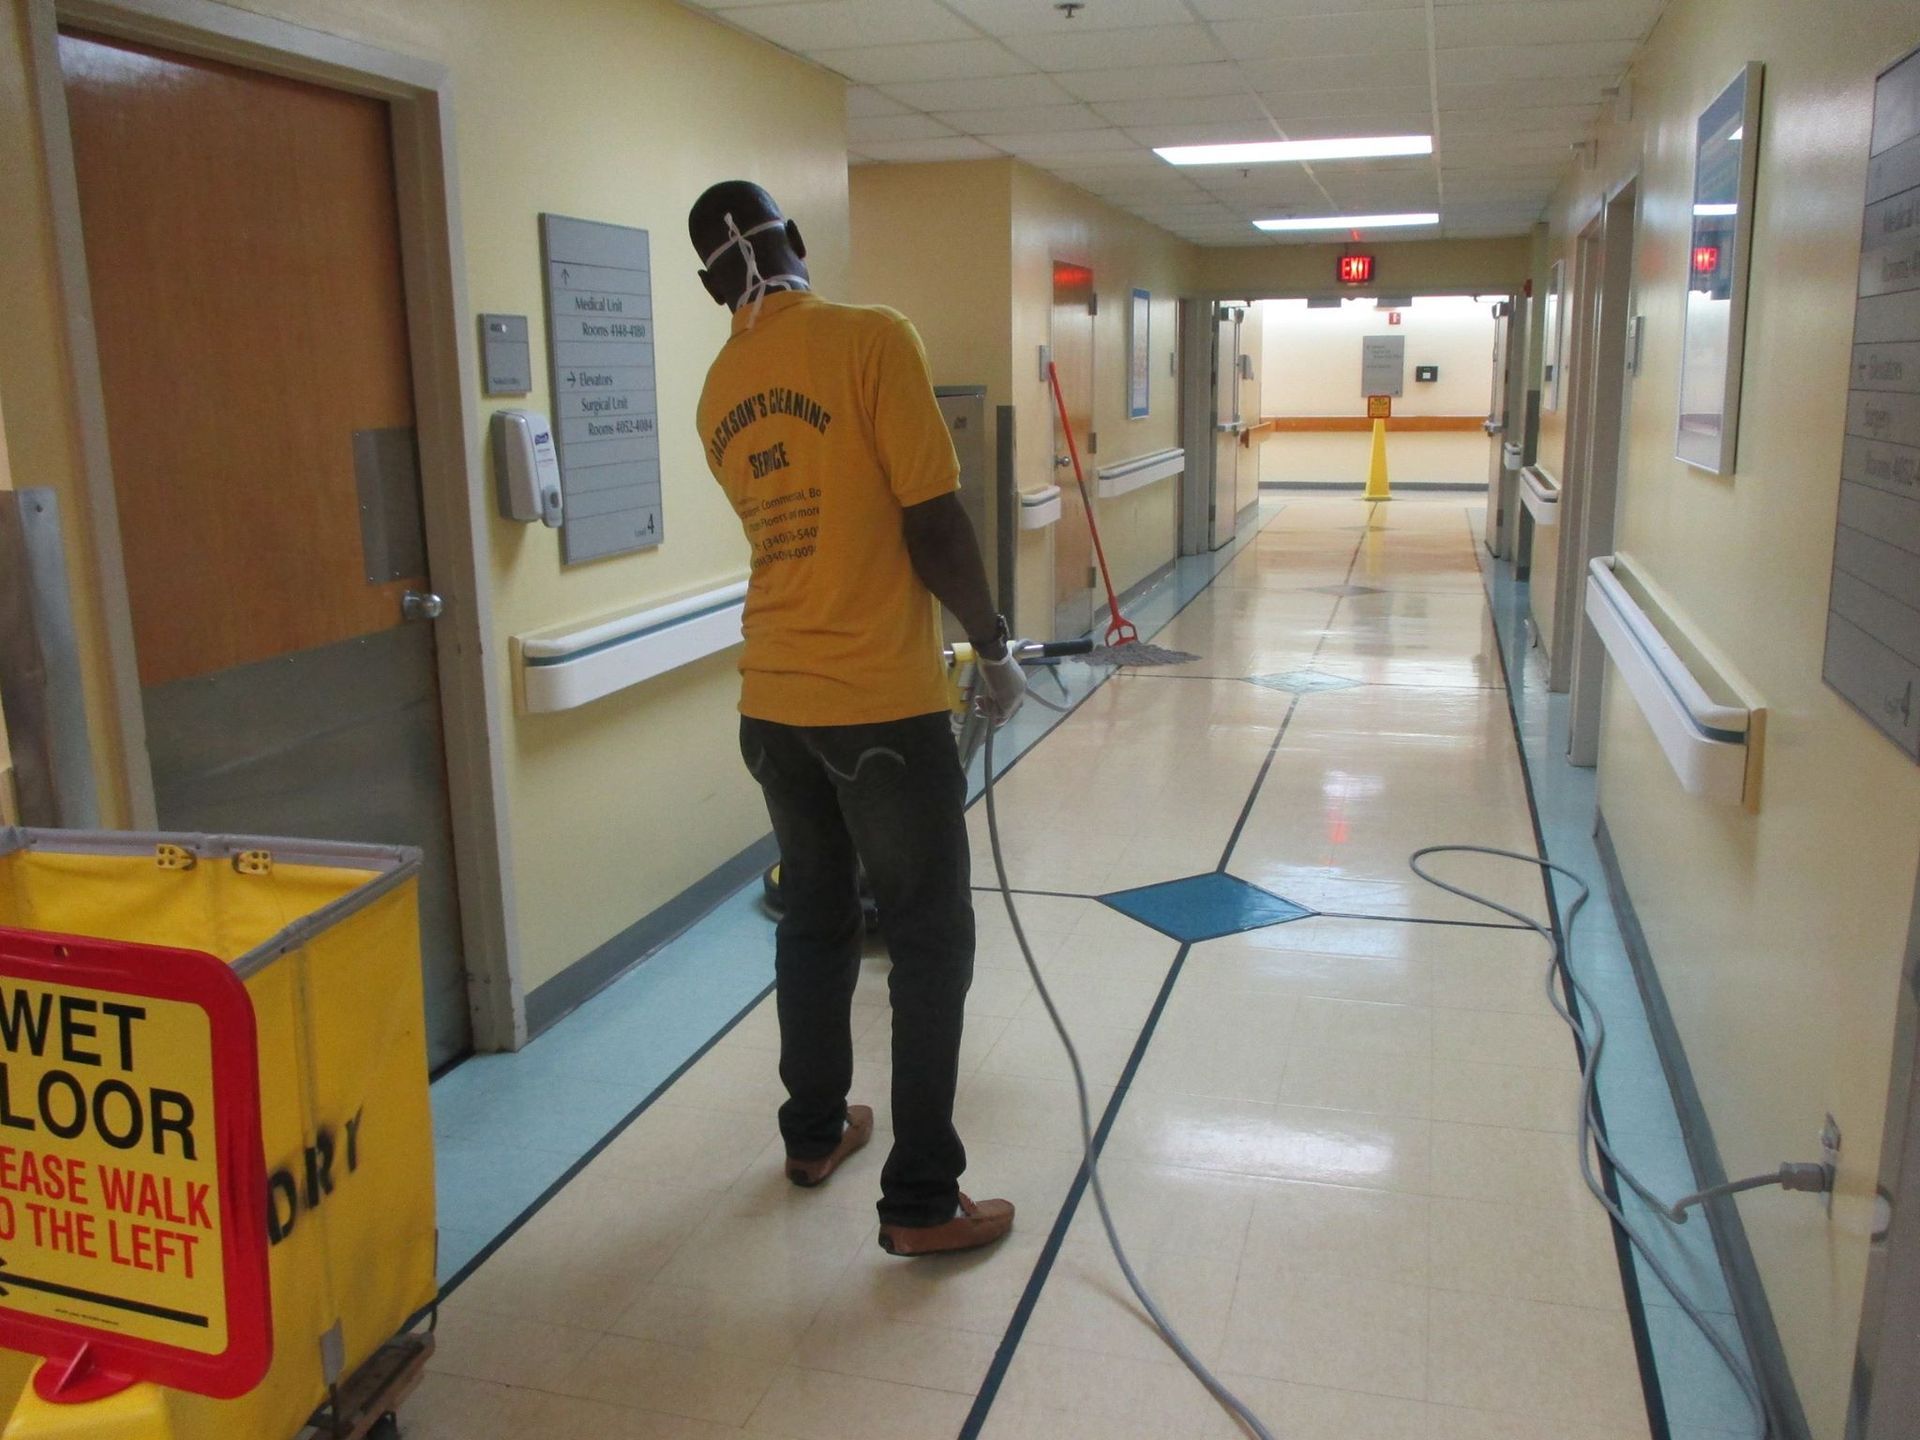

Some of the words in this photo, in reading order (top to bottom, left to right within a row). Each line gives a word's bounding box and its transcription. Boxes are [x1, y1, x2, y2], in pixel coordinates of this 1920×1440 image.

[1341, 257, 1372, 281] EXIT
[575, 295, 605, 311] Medical
[607, 297, 622, 312] Unit
[582, 322, 609, 337] Rooms
[579, 372, 613, 387] Elevators
[581, 397, 611, 415] Surgical
[588, 422, 614, 436] Rooms
[710, 393, 768, 467] JACKSON'S
[769, 387, 831, 435] CLEANING
[647, 513, 655, 535] 4
[0, 986, 146, 1072] WET
[0, 1062, 198, 1161] LOOR
[0, 1146, 89, 1205] EASE
[98, 1165, 213, 1229] WALK
[0, 1196, 15, 1241] O
[25, 1203, 97, 1259] THE
[109, 1219, 199, 1280] LEFT
